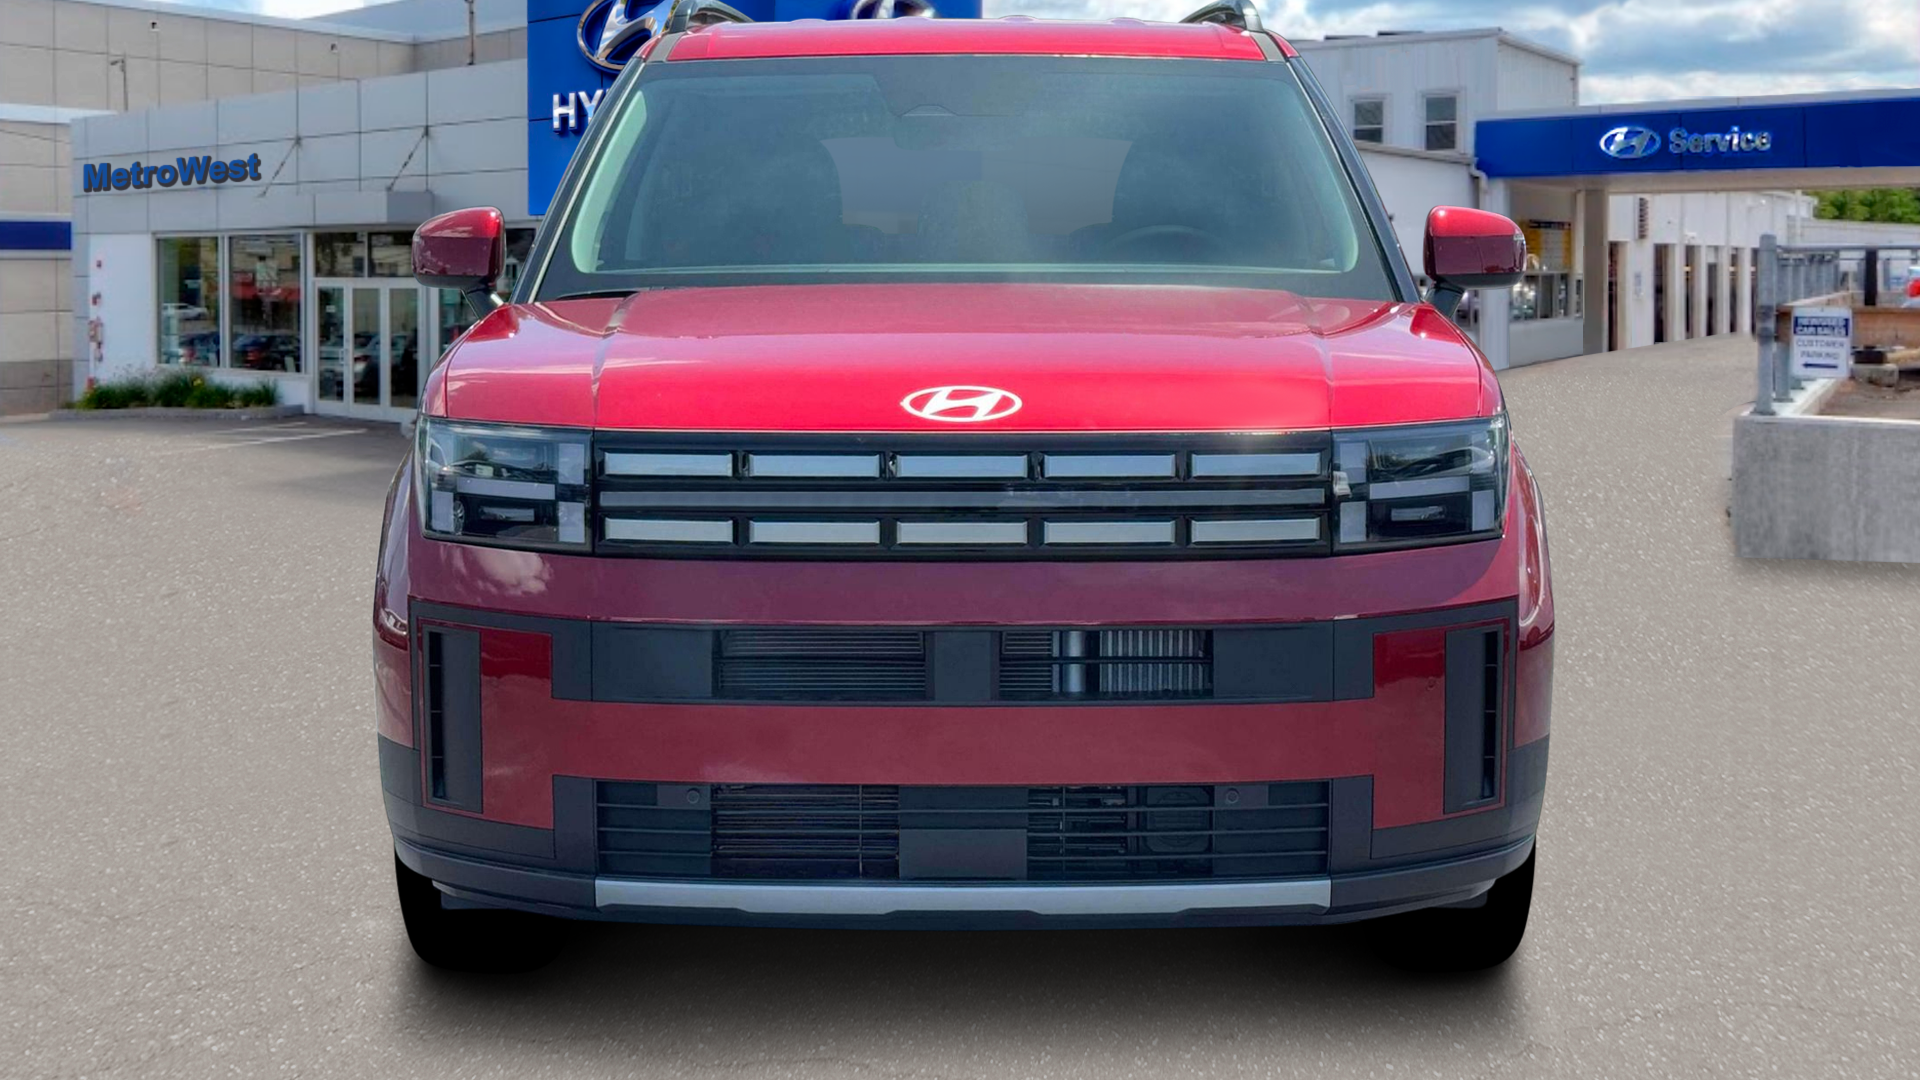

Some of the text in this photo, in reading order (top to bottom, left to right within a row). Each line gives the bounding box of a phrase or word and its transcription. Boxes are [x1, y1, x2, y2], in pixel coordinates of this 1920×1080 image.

[552, 88, 609, 130] HY
[1669, 125, 1772, 153] Service
[83, 152, 262, 193] MetroWest
[1797, 326, 1846, 336] CAR SALES
[1796, 339, 1845, 348] CUSTOMER
[1800, 350, 1840, 360] PARKING
